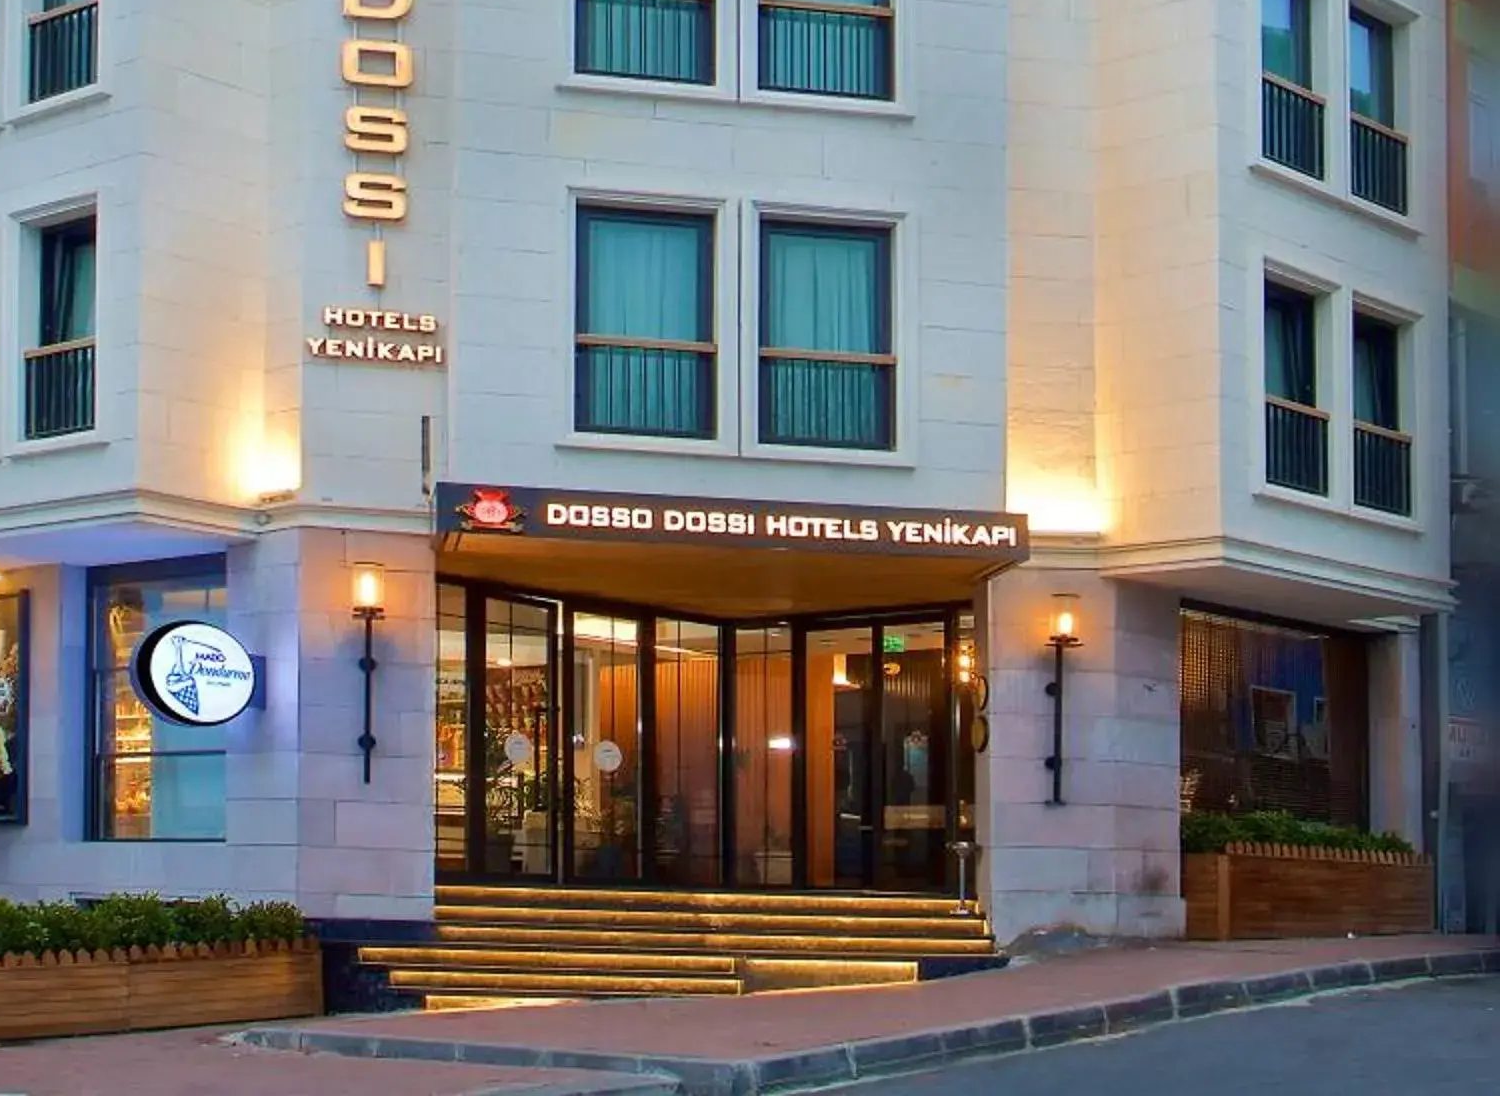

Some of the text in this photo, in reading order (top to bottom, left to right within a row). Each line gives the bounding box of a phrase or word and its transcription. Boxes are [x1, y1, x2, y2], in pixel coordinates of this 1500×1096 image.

[322, 306, 438, 333] HOTELS
[306, 336, 443, 364] YENİKAPI
[546, 503, 1017, 547] DOSSO DOSSI HOTELS YENİKAPI
